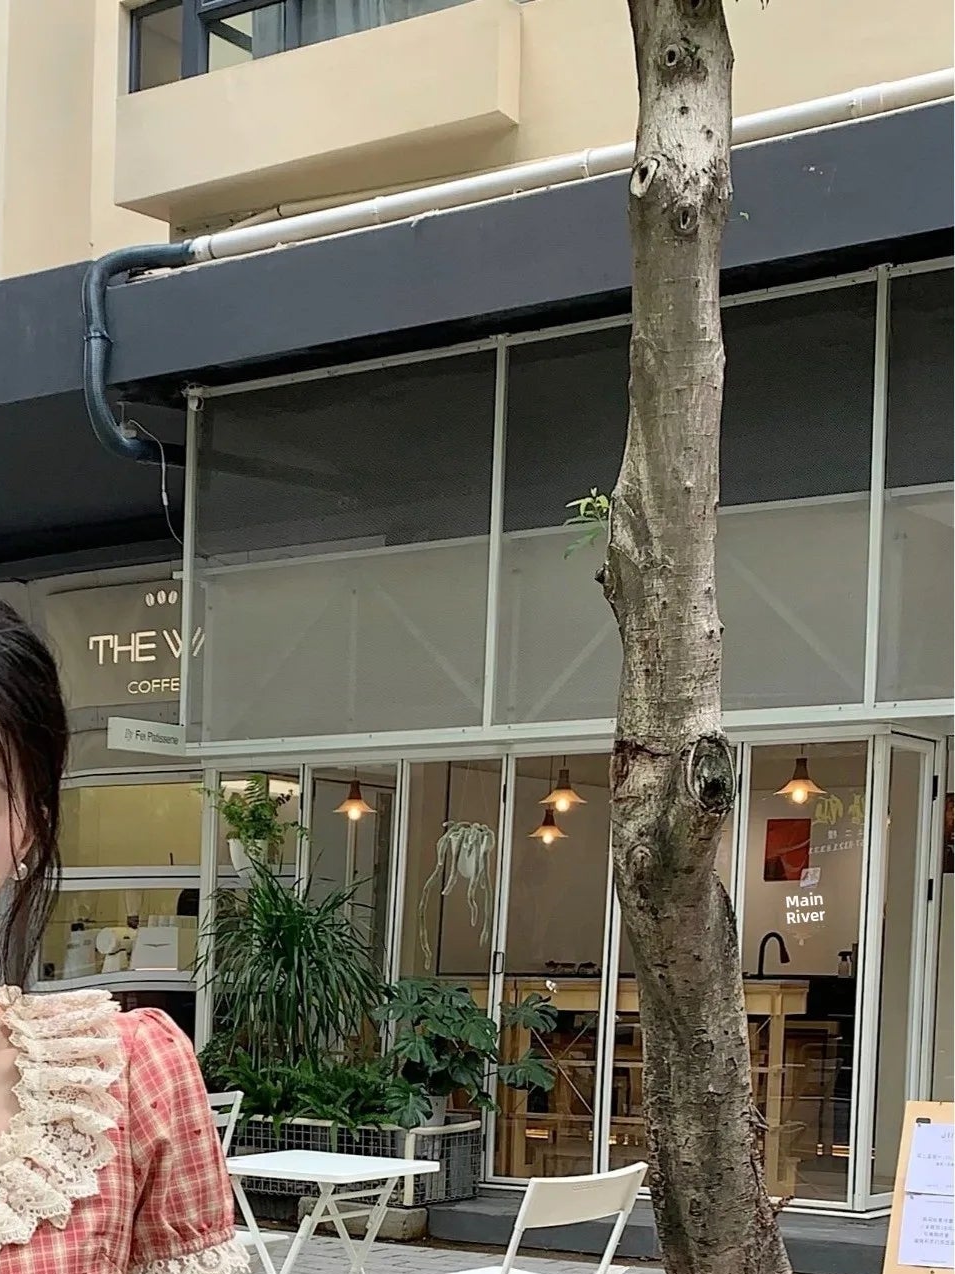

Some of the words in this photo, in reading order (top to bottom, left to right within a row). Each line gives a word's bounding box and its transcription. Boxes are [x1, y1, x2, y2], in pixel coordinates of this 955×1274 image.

[89, 630, 157, 665] THE
[127, 678, 180, 694] COFFE
[785, 892, 824, 908] Main
[786, 909, 825, 924] River
